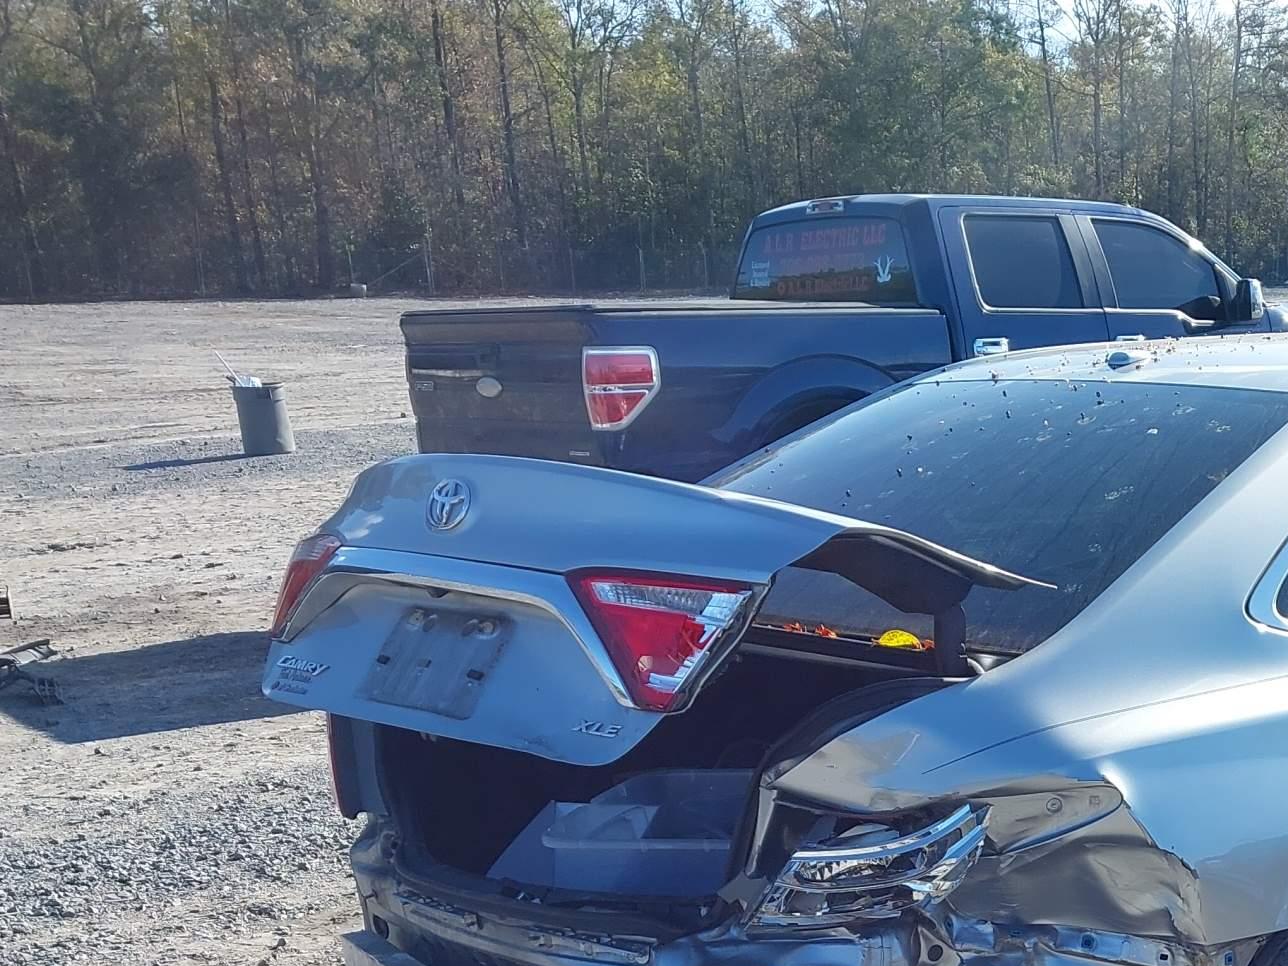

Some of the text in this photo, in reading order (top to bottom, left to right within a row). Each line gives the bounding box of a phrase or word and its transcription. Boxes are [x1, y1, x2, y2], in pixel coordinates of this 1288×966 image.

[800, 226, 859, 251] ELECTRIC
[863, 223, 887, 245] LLC
[277, 655, 330, 676] CAMRY
[571, 718, 623, 738] XLE
